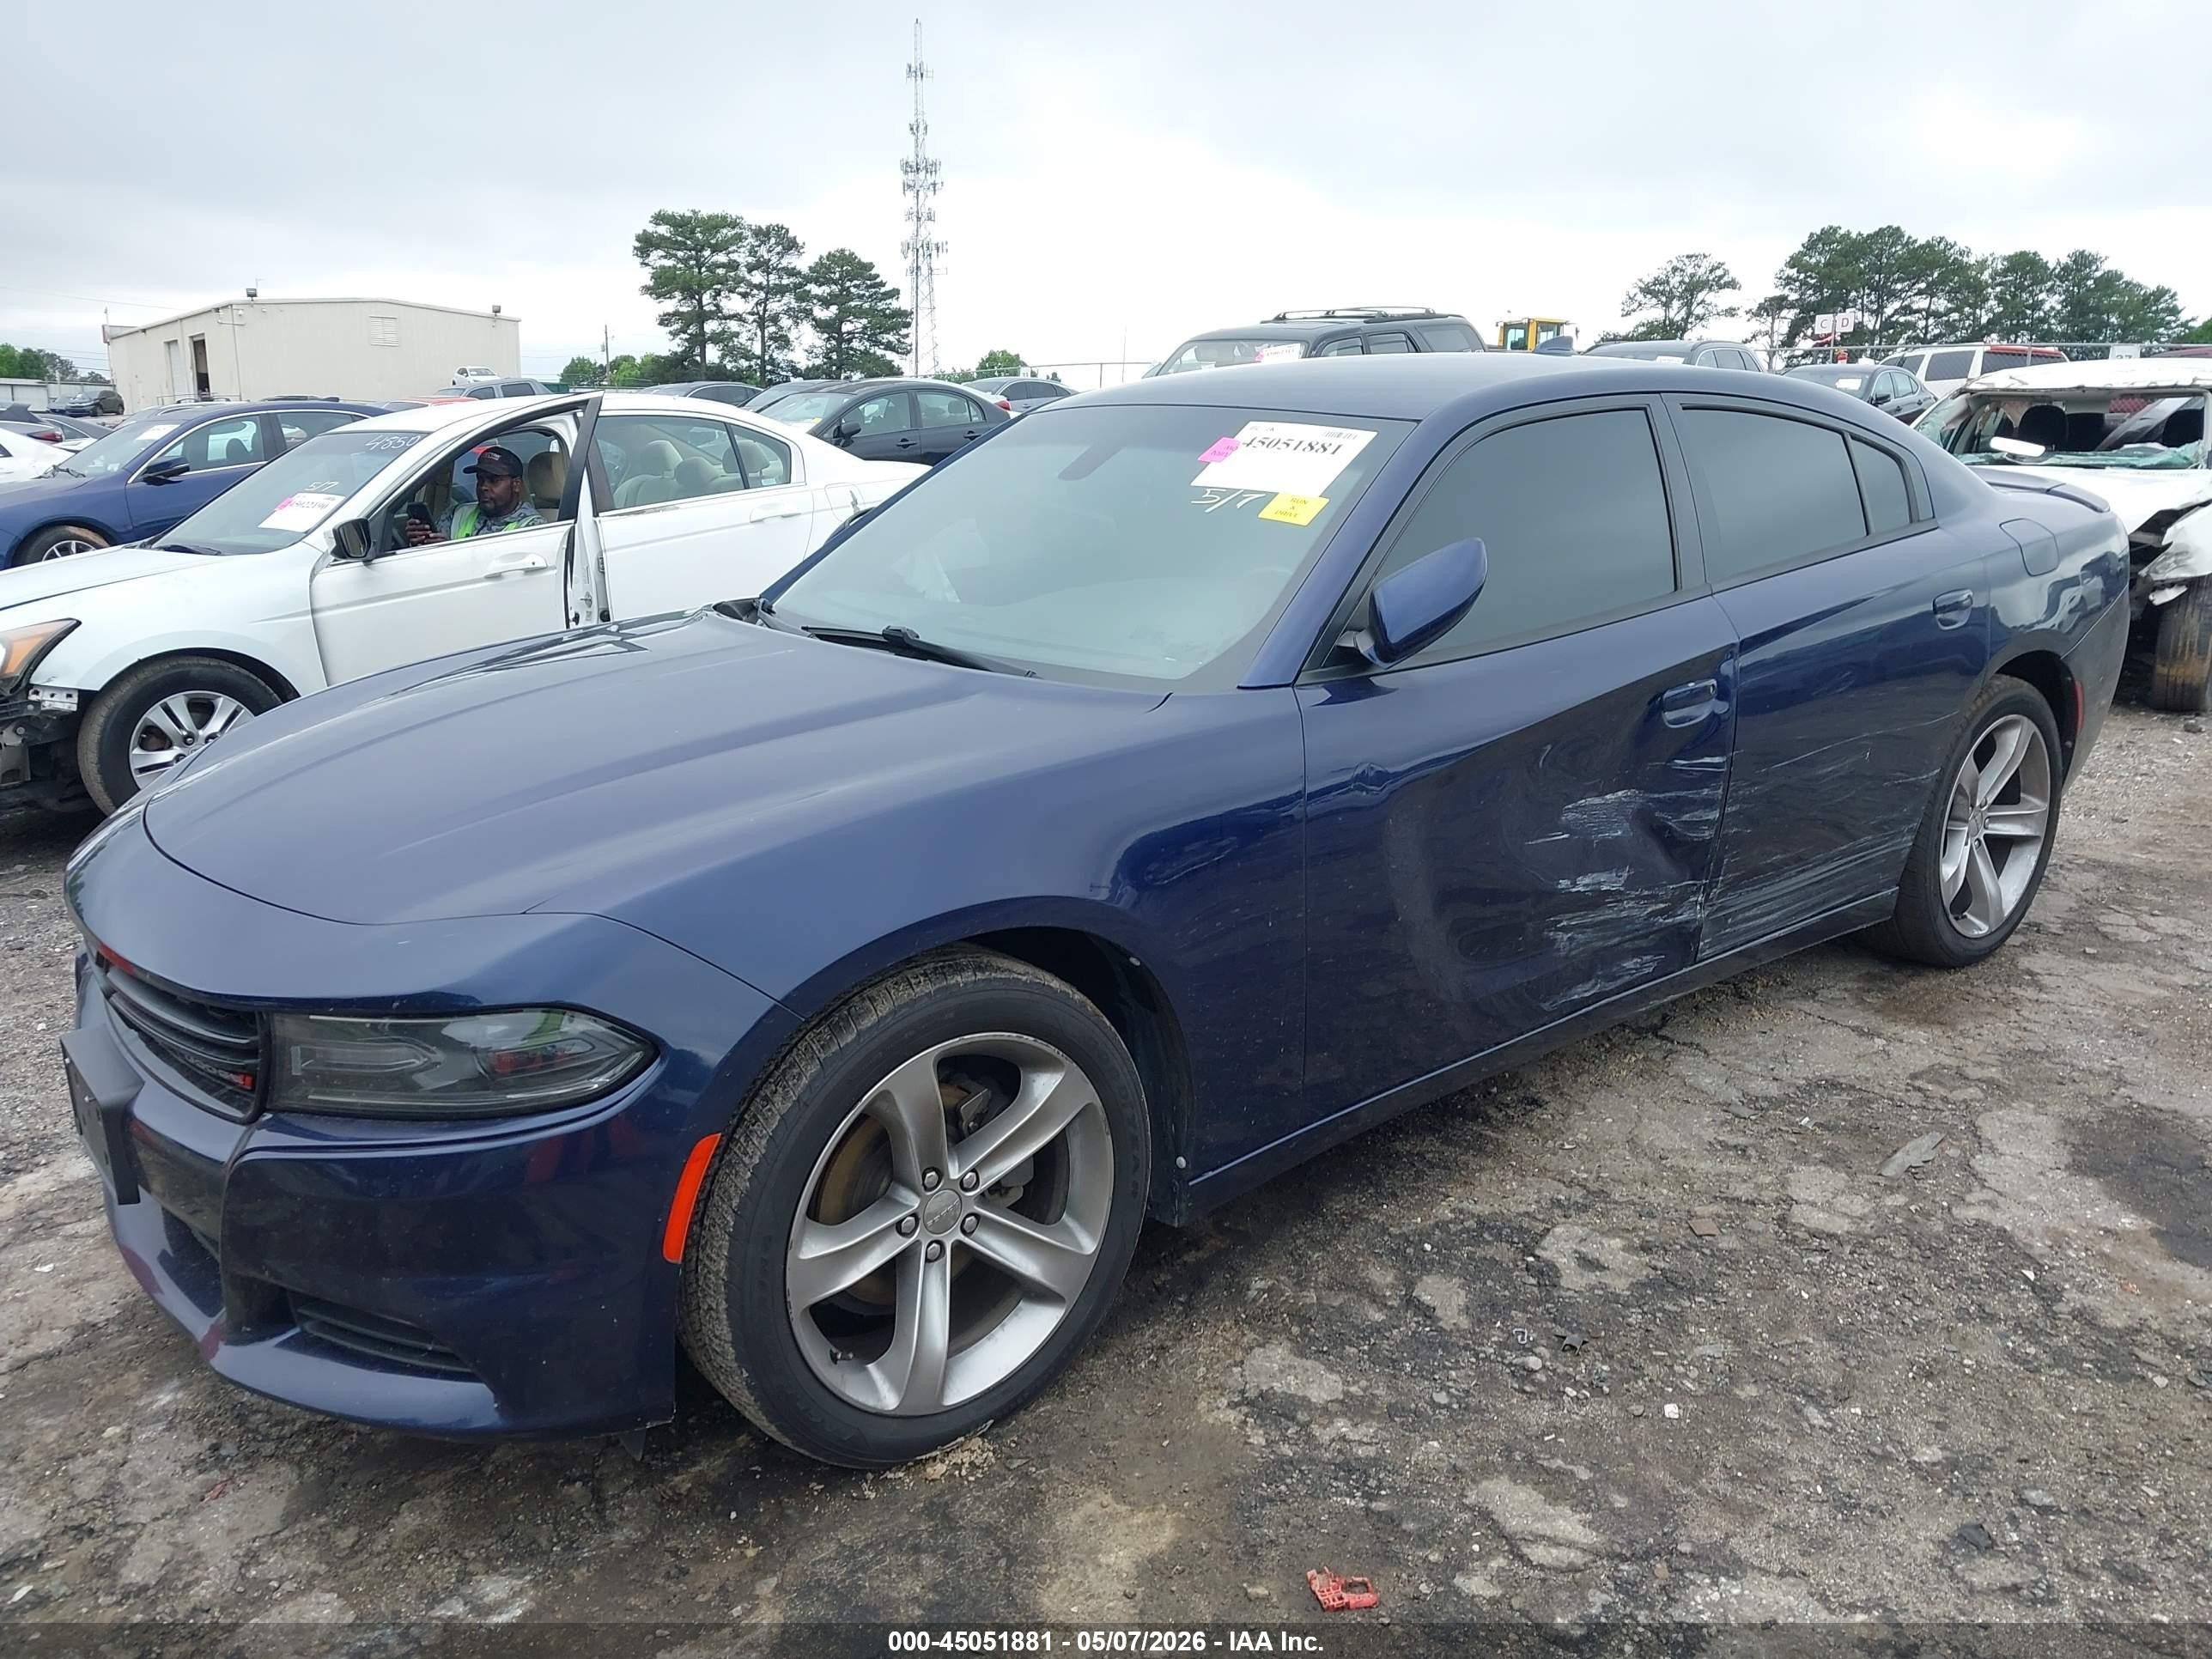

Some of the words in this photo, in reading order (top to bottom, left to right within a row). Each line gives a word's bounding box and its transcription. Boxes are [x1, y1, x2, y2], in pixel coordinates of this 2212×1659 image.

[1820, 319, 1827, 329] C
[1841, 318, 1849, 327] D
[1242, 435, 1346, 456] 45051881
[1191, 488, 1267, 513] 5/7
